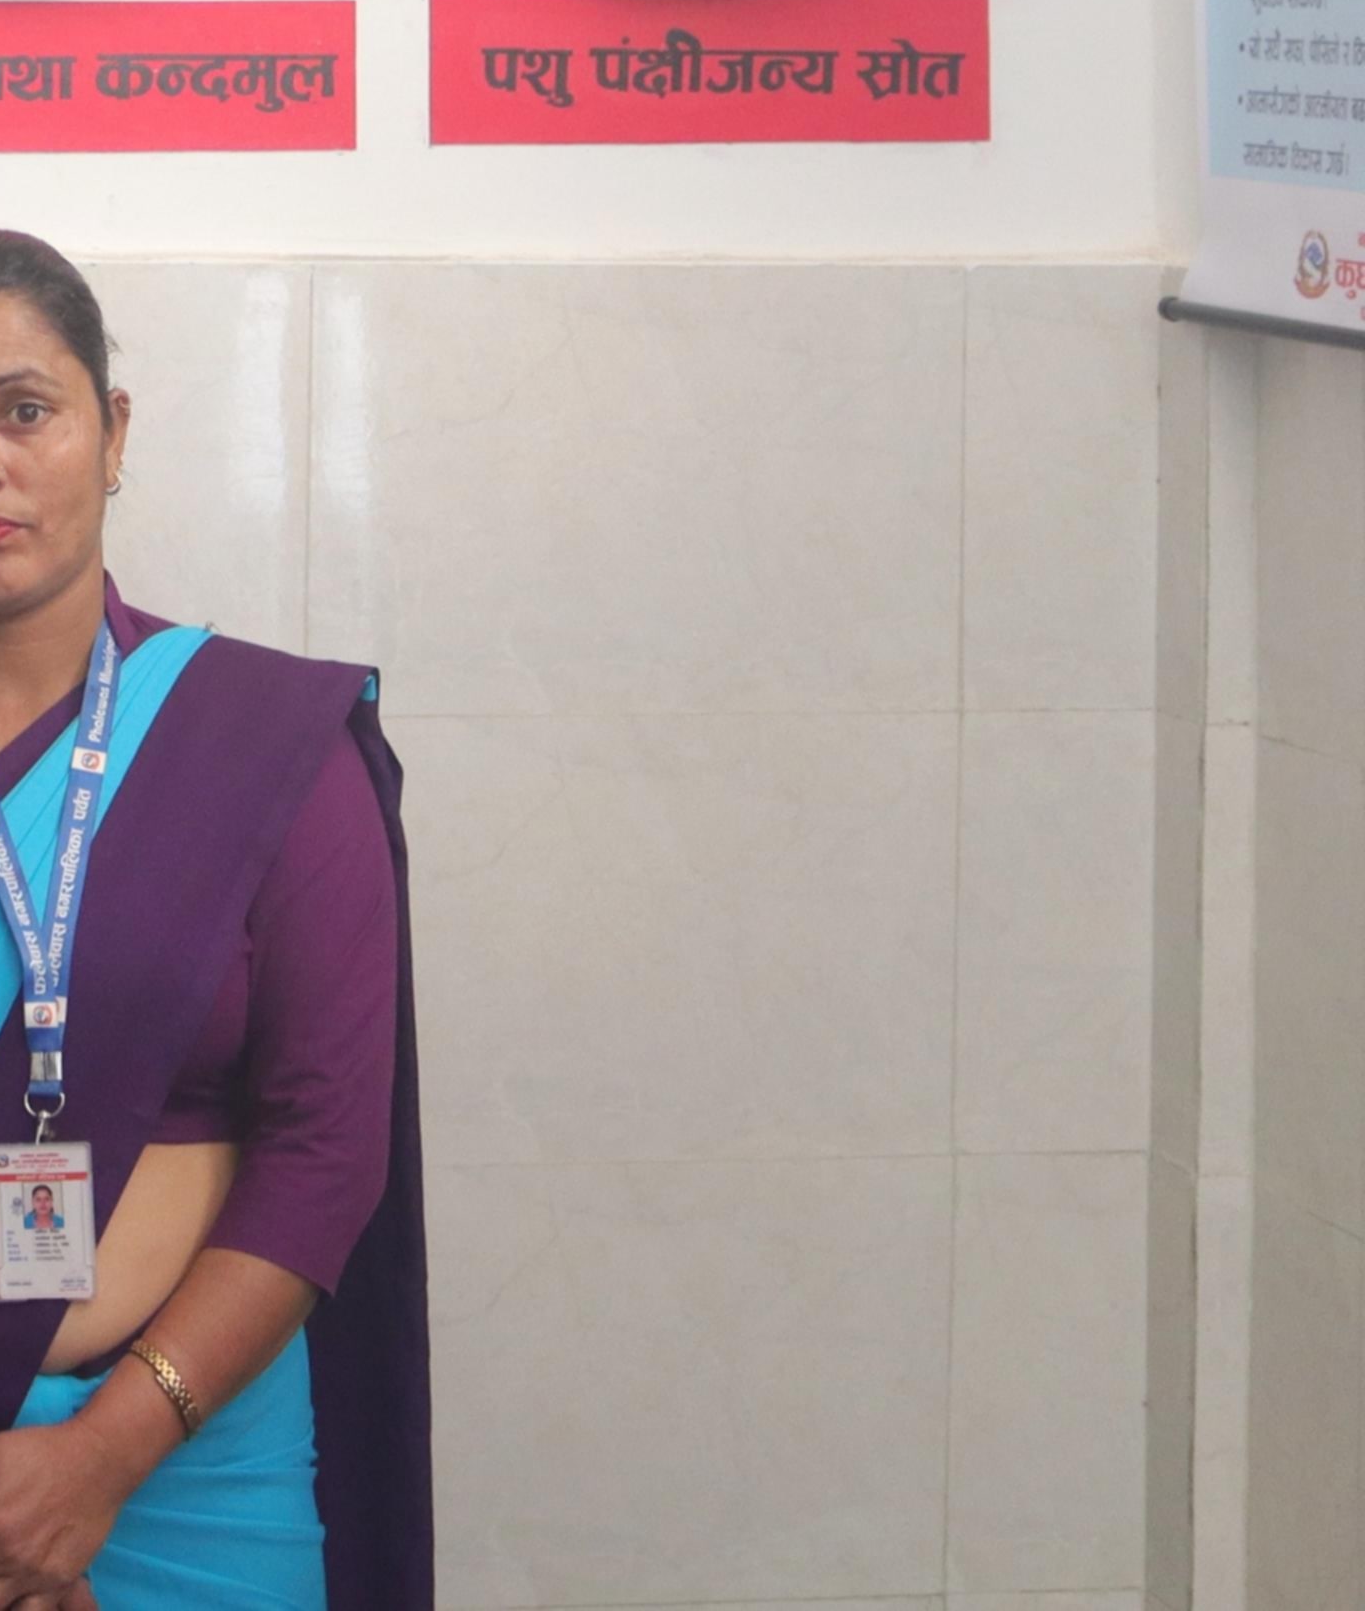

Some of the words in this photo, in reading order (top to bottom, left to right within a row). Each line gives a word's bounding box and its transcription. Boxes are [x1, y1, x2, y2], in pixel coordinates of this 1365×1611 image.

[95, 52, 340, 114] कन्दमुल
[480, 47, 575, 108] पशु
[590, 28, 840, 100] पंक्षीजन्य
[88, 689, 110, 743] Phalewas
[72, 787, 92, 821] पर्वत
[23, 929, 47, 996] फलेवास
